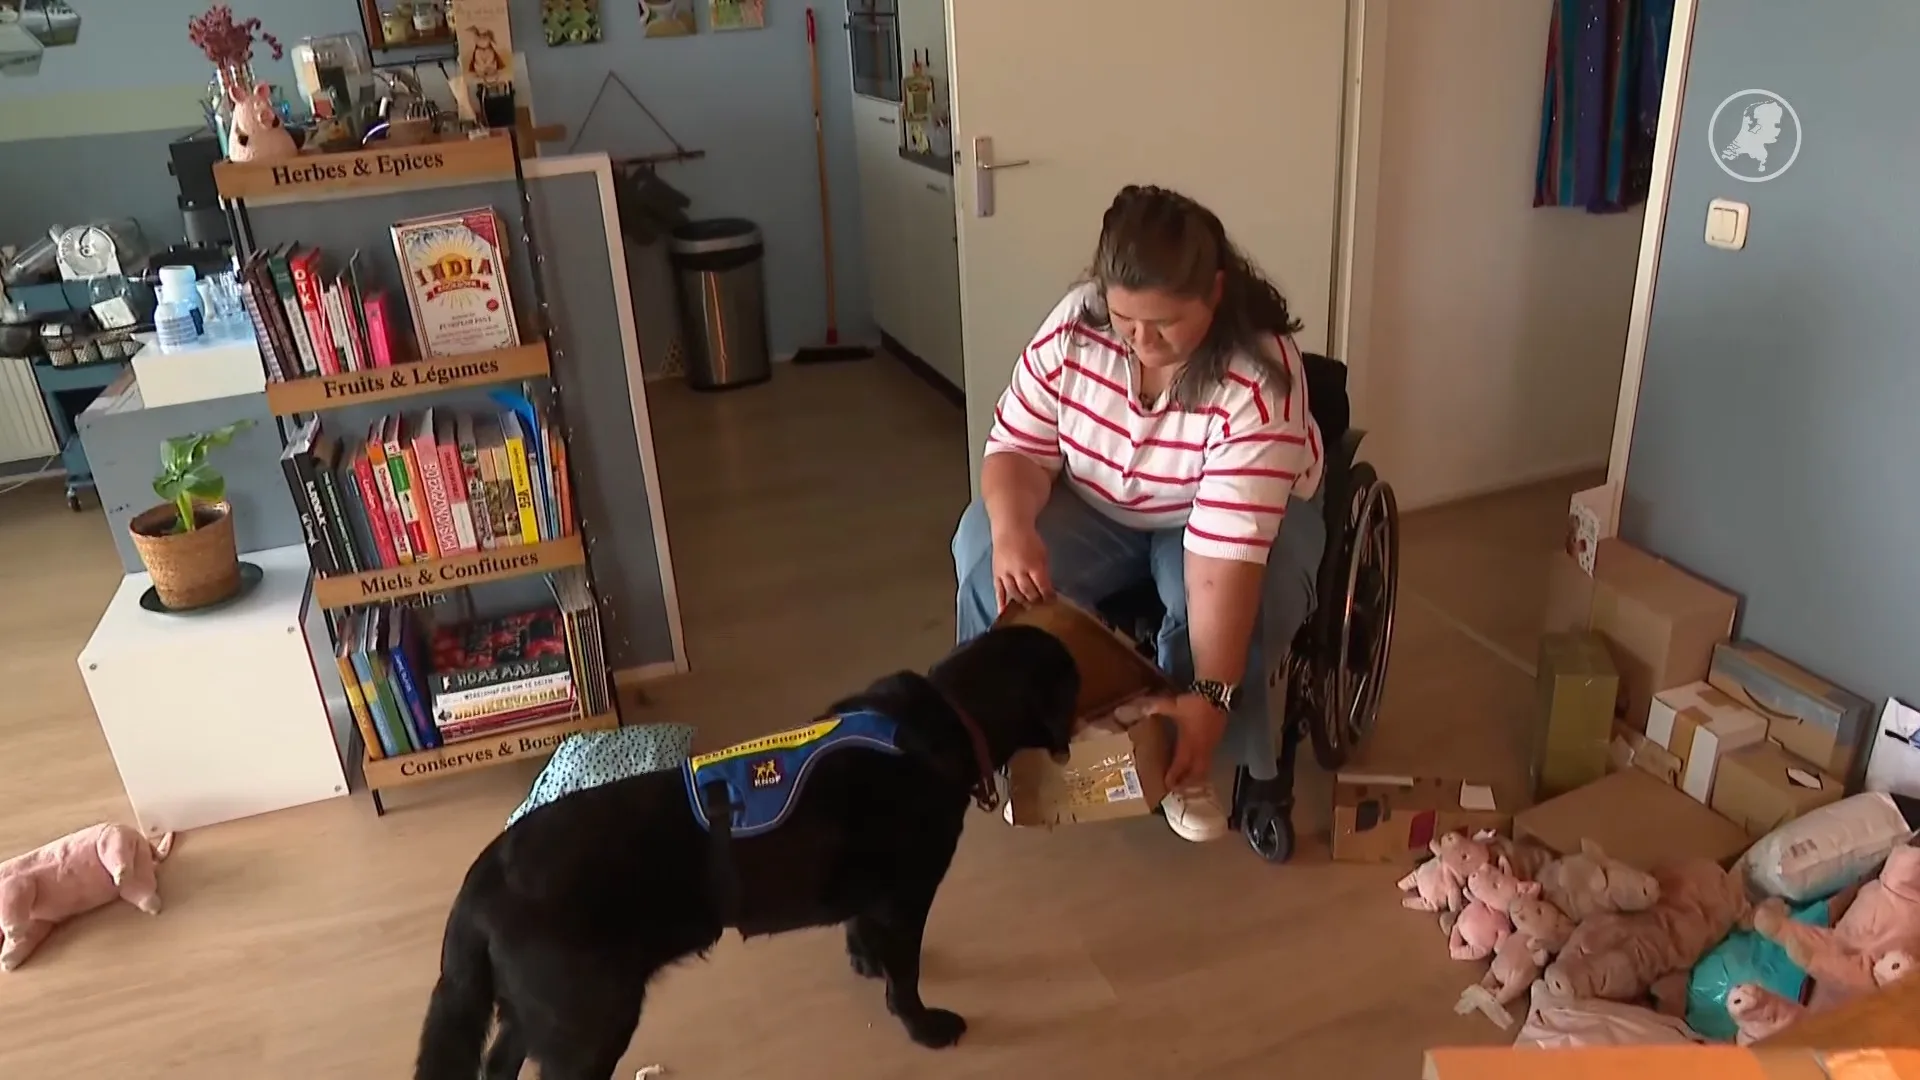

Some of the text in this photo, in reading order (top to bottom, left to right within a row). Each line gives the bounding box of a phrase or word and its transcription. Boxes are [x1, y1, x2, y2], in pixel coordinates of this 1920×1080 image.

[271, 152, 444, 186] Herbes & Epices
[294, 269, 313, 306] OTK
[414, 258, 493, 287] INDIA
[323, 359, 499, 399] Fruits & Légumes
[517, 489, 531, 509] VEG
[360, 552, 539, 596] Miels & Confitures
[456, 660, 541, 687] HOME MADE
[400, 730, 581, 777] Conserves & Bocau
